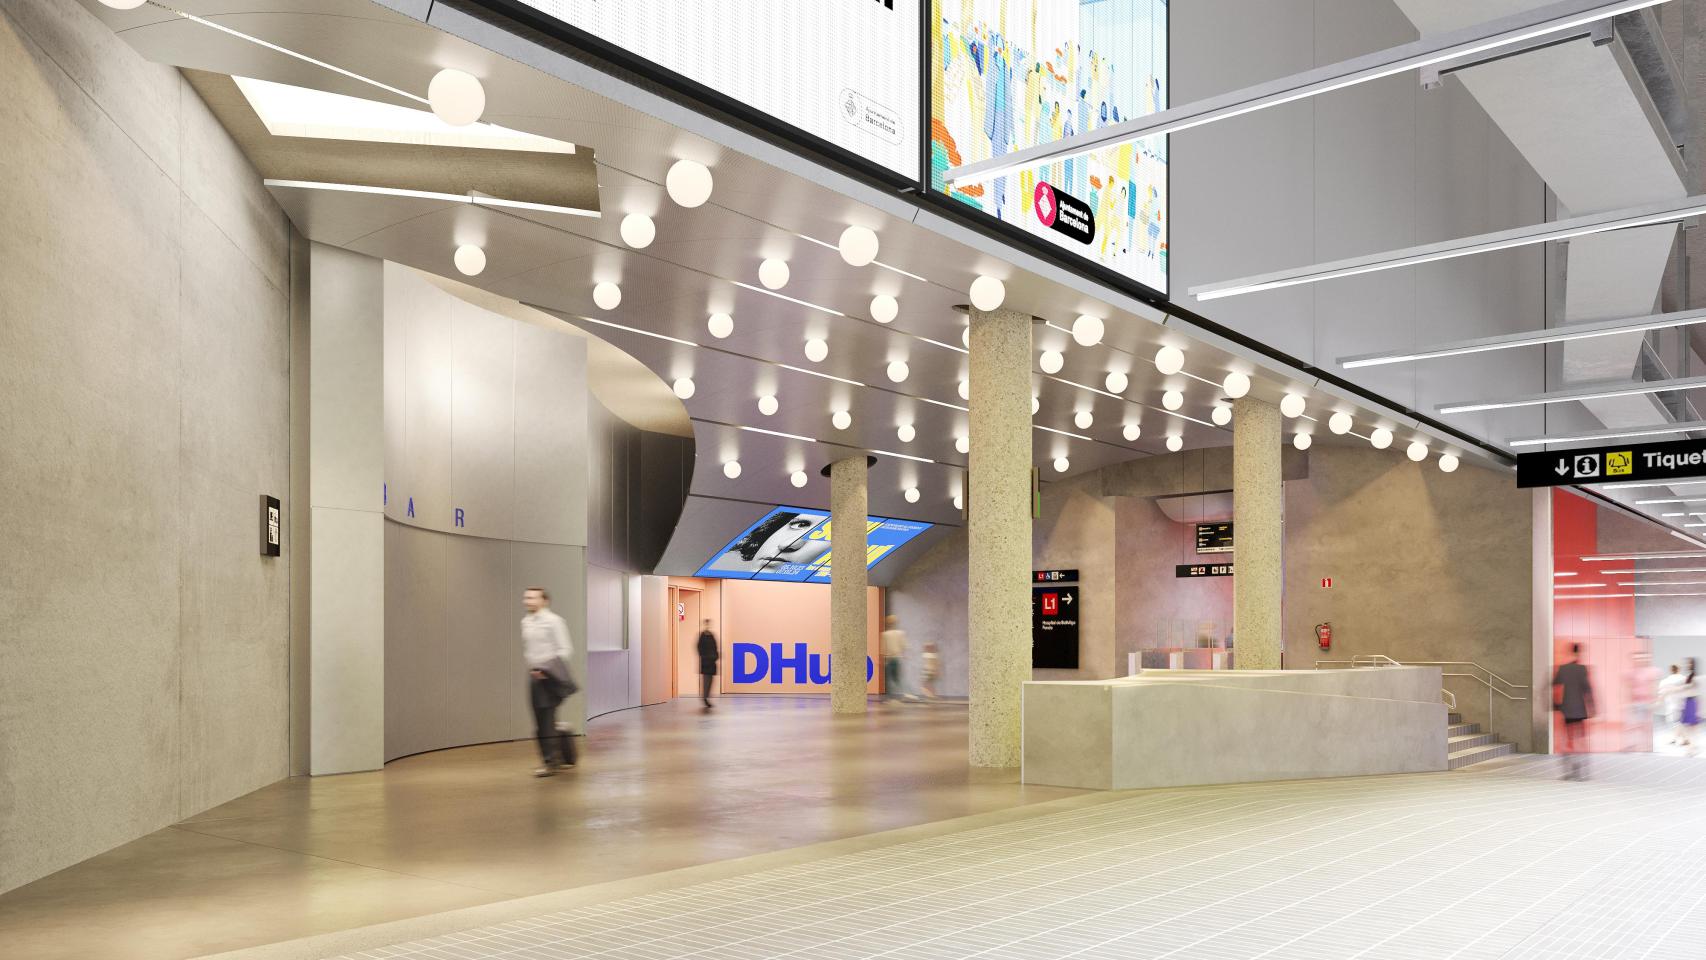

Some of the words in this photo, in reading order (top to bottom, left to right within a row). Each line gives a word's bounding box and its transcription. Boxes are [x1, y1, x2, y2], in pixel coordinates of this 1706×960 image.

[865, 113, 896, 135] Barcelona
[1059, 209, 1089, 234] Barcelona
[1044, 598, 1056, 610] L1
[732, 642, 874, 685] DHu
